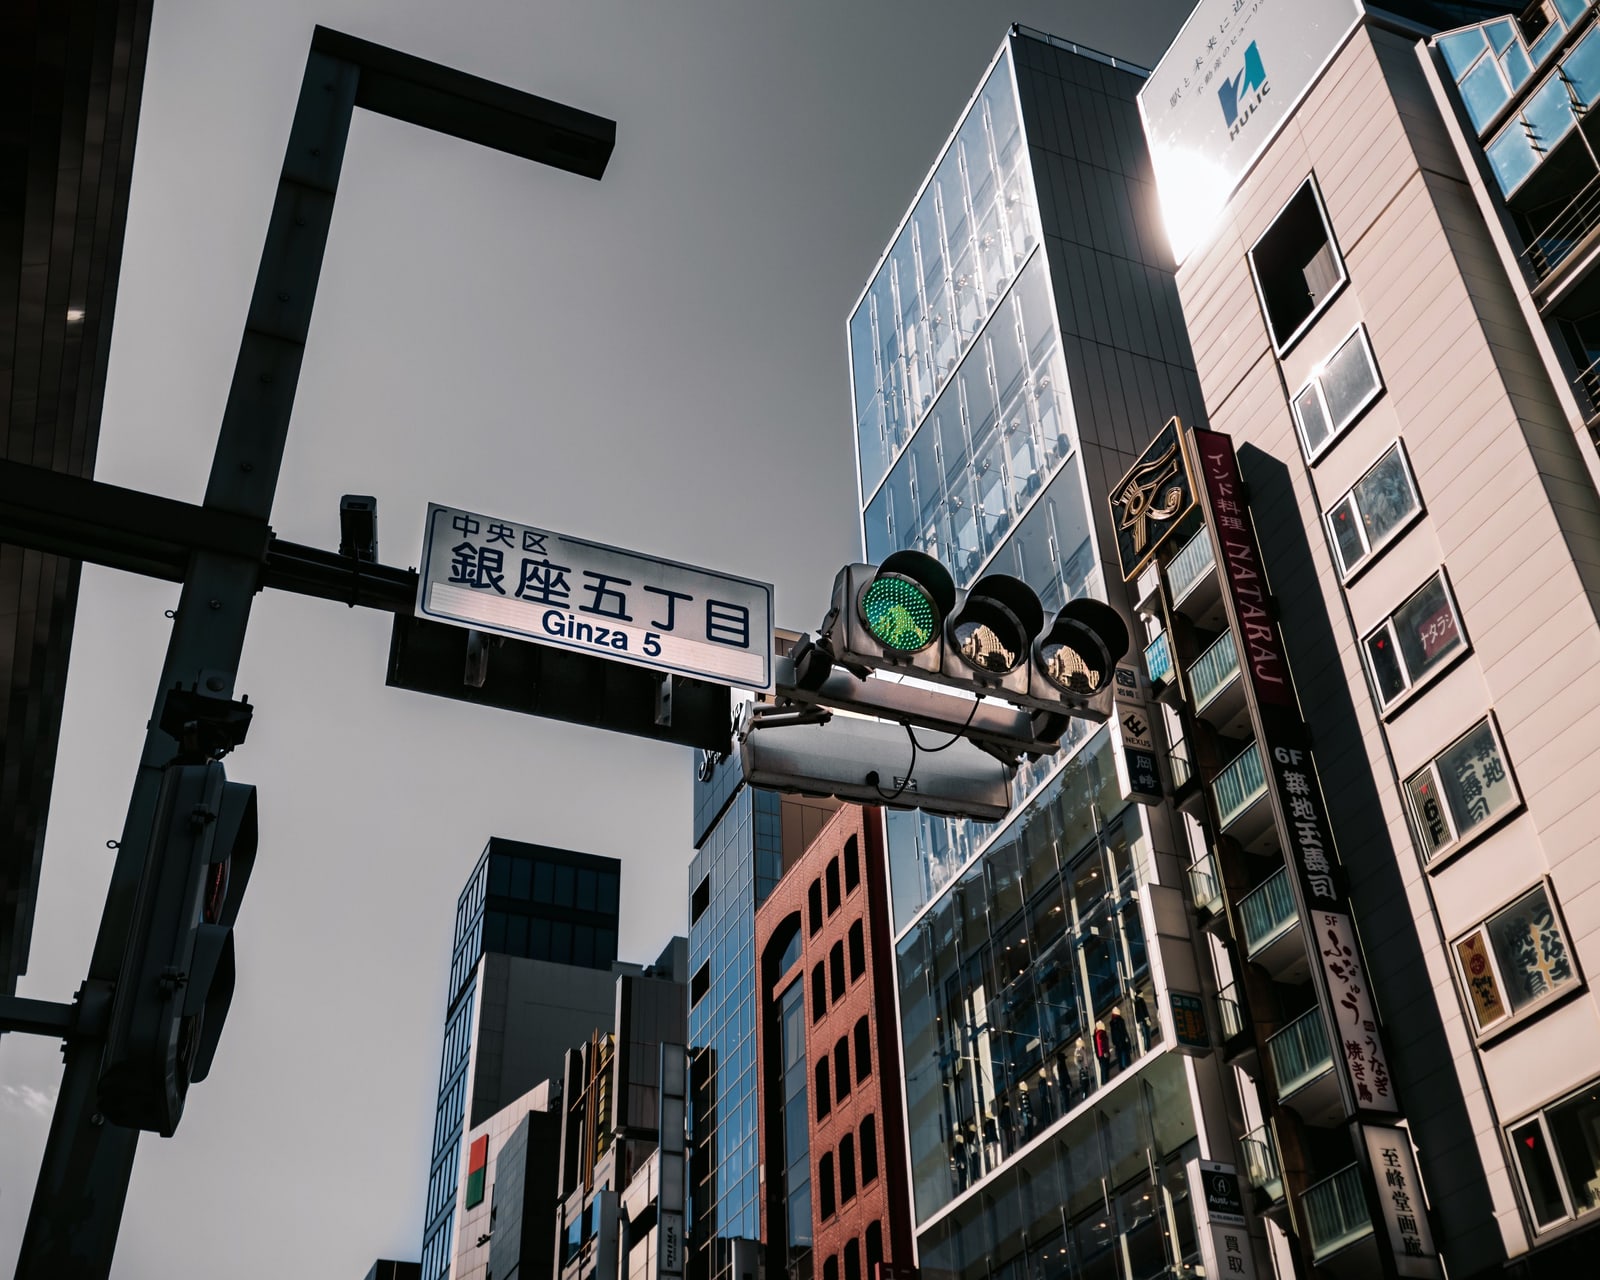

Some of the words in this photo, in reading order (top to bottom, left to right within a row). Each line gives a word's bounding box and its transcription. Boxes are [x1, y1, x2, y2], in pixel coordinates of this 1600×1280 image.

[1229, 80, 1271, 142] HULIC
[1207, 454, 1247, 532] インド料理
[452, 514, 549, 556] 中央区
[448, 541, 750, 649] 銀座五丁目
[1226, 540, 1284, 685] NATARAJ
[541, 609, 628, 651] Ginza
[642, 632, 662, 657] 5
[1125, 737, 1152, 748] NEXUS
[1274, 746, 1303, 766] 6F
[1428, 798, 1449, 847] 6F
[1324, 915, 1339, 927] 5F
[1345, 1039, 1373, 1103] 焼き鳥
[1380, 1147, 1424, 1257] 至峰堂画廊
[1224, 1234, 1246, 1275] 買取
